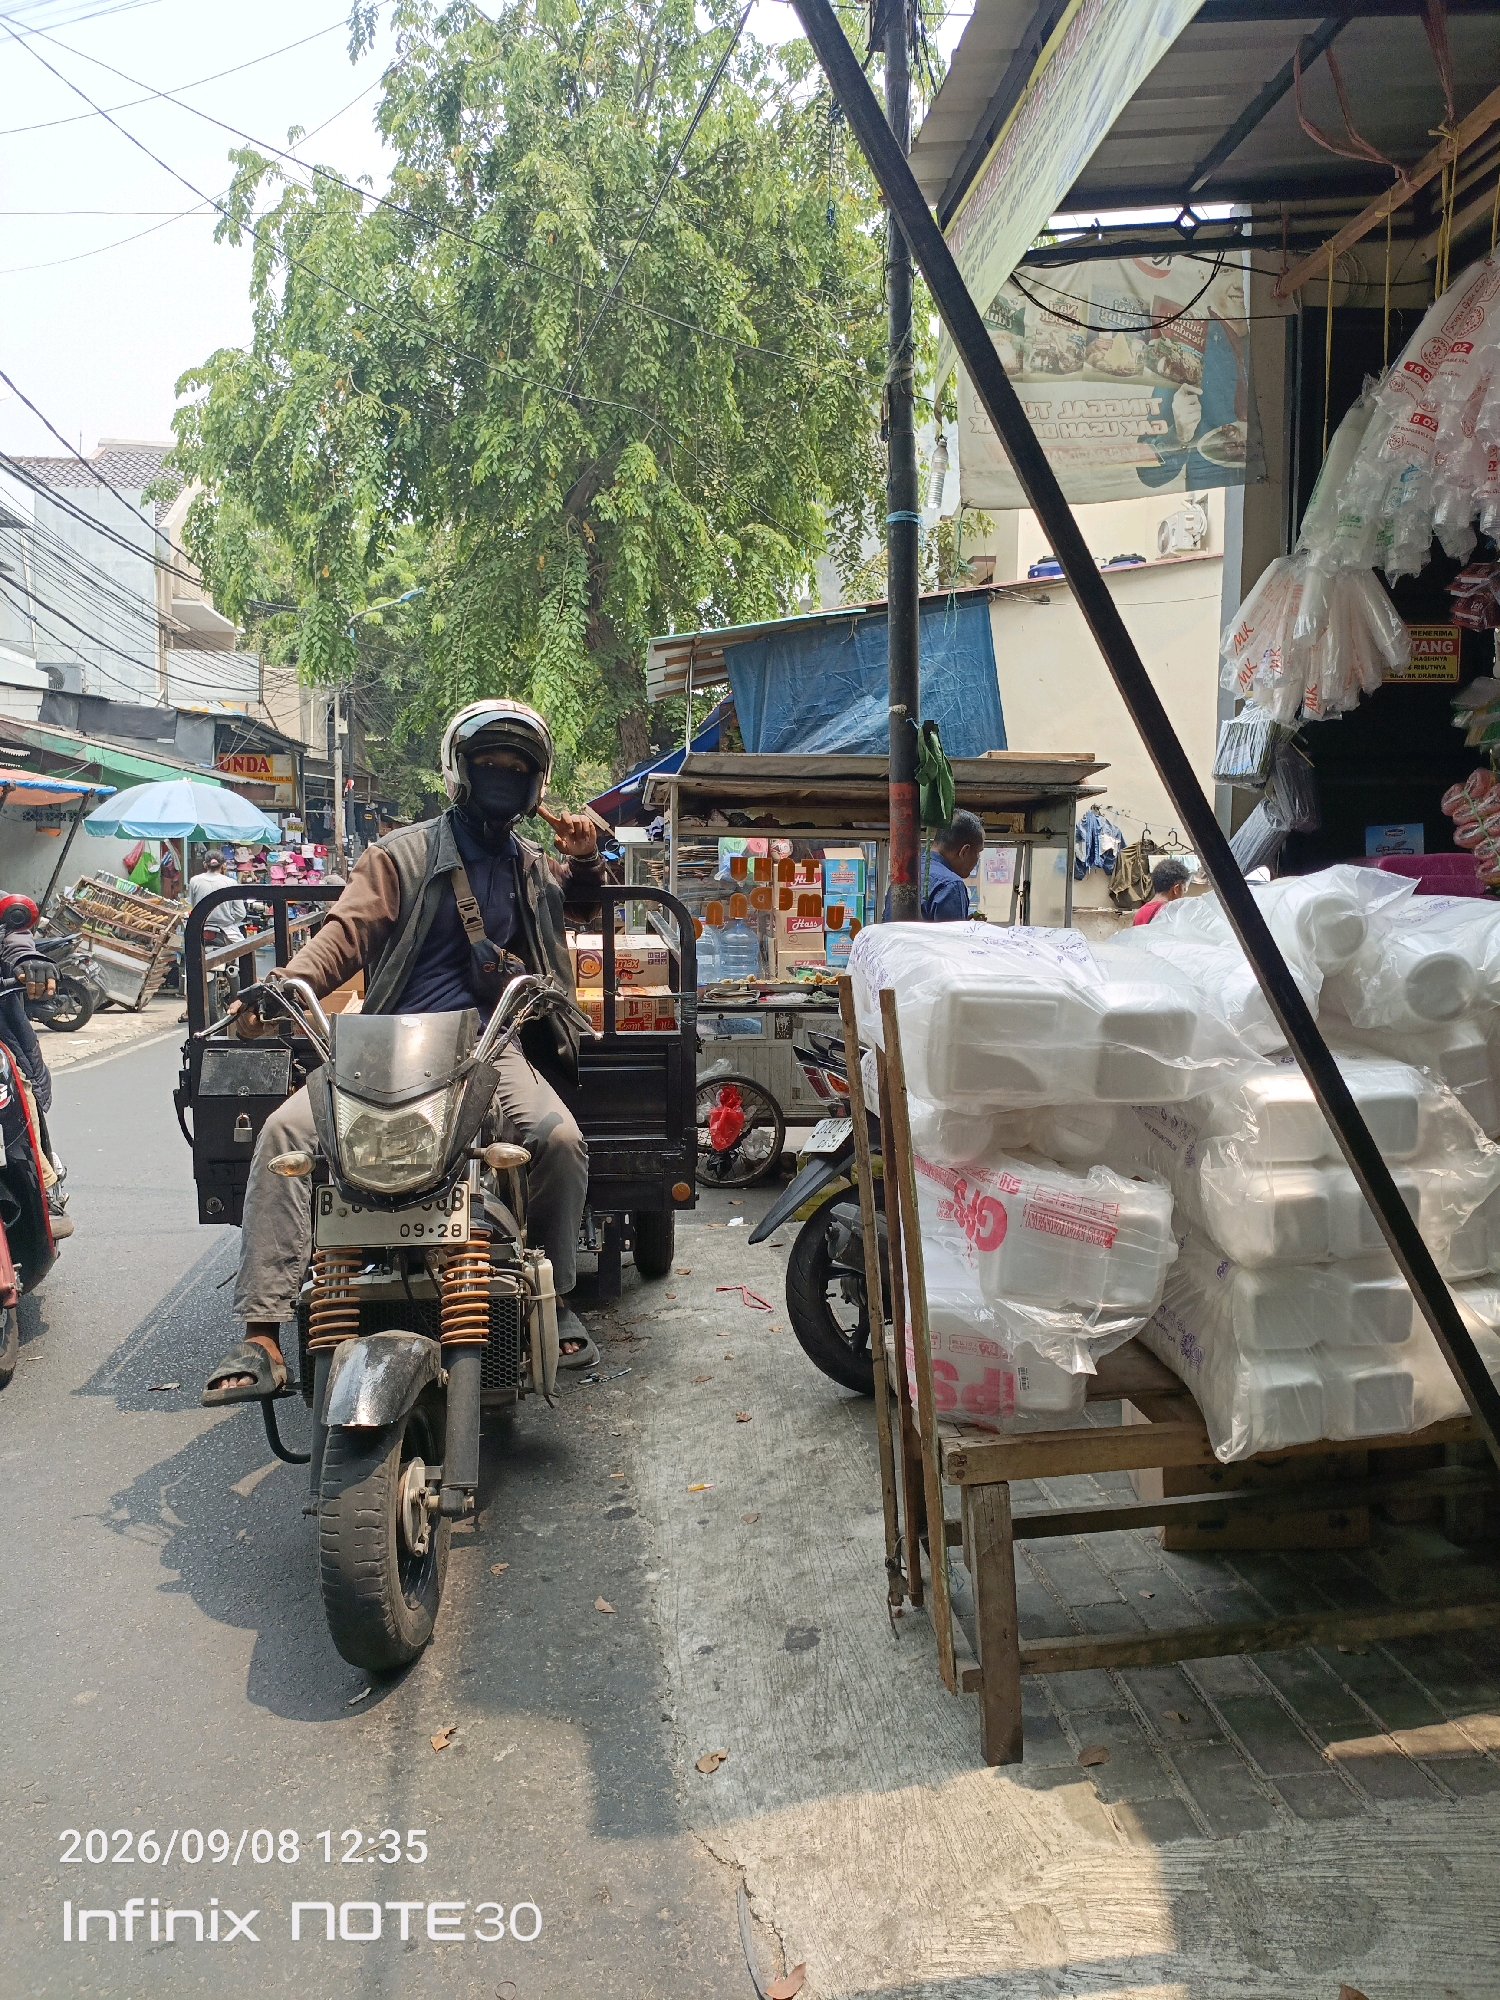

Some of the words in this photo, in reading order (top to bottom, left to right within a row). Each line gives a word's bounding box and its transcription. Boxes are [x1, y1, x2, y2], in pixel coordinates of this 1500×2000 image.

[1233, 621, 1255, 656] MK
[1410, 640, 1454, 653] TANG
[1237, 657, 1258, 693] MK
[1305, 683, 1322, 715] MK
[791, 918, 819, 932] Hass
[320, 1190, 333, 1216] B
